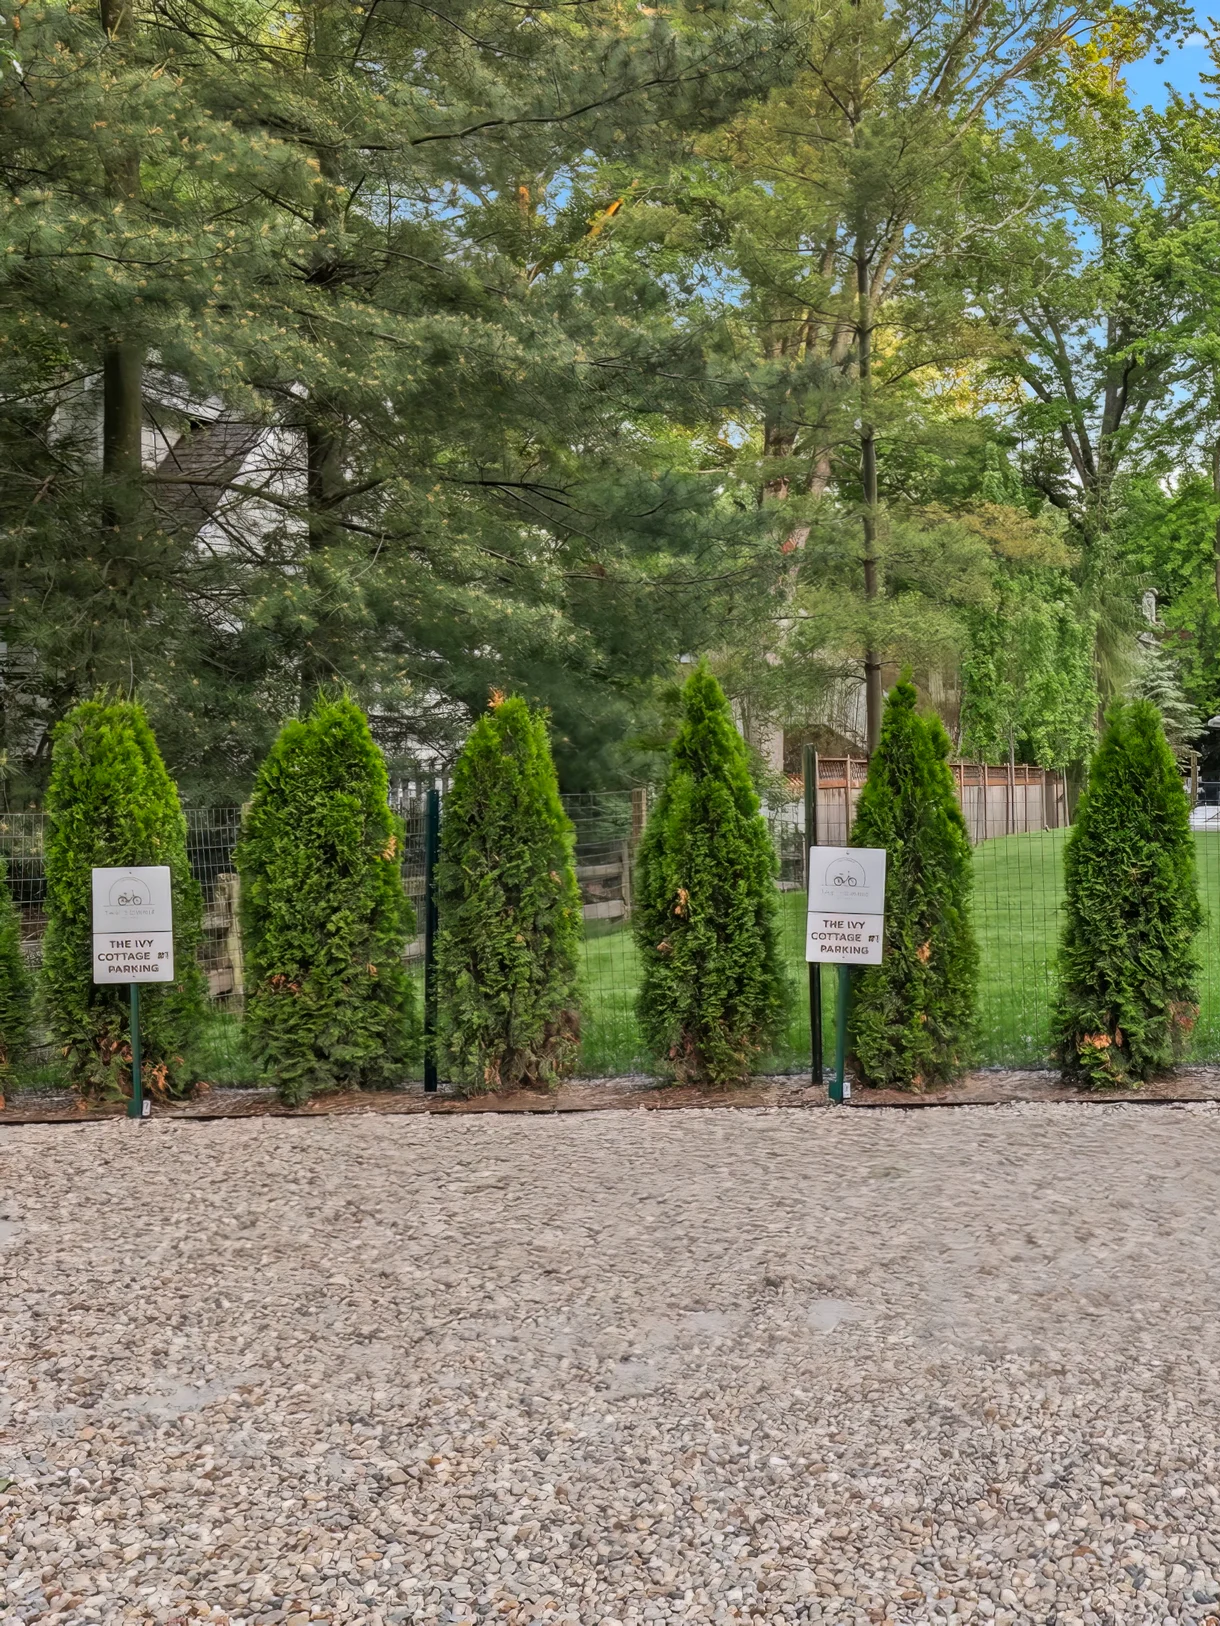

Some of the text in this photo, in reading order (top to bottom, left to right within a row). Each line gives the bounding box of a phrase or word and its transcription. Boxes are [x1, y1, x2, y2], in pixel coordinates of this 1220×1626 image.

[823, 920, 866, 930] THE IVY
[811, 932, 862, 942] COTTAGE
[109, 939, 154, 949] THE IVY
[820, 945, 869, 955] PARKING
[97, 952, 151, 962] COTTAGE
[108, 964, 160, 974] PARKING
